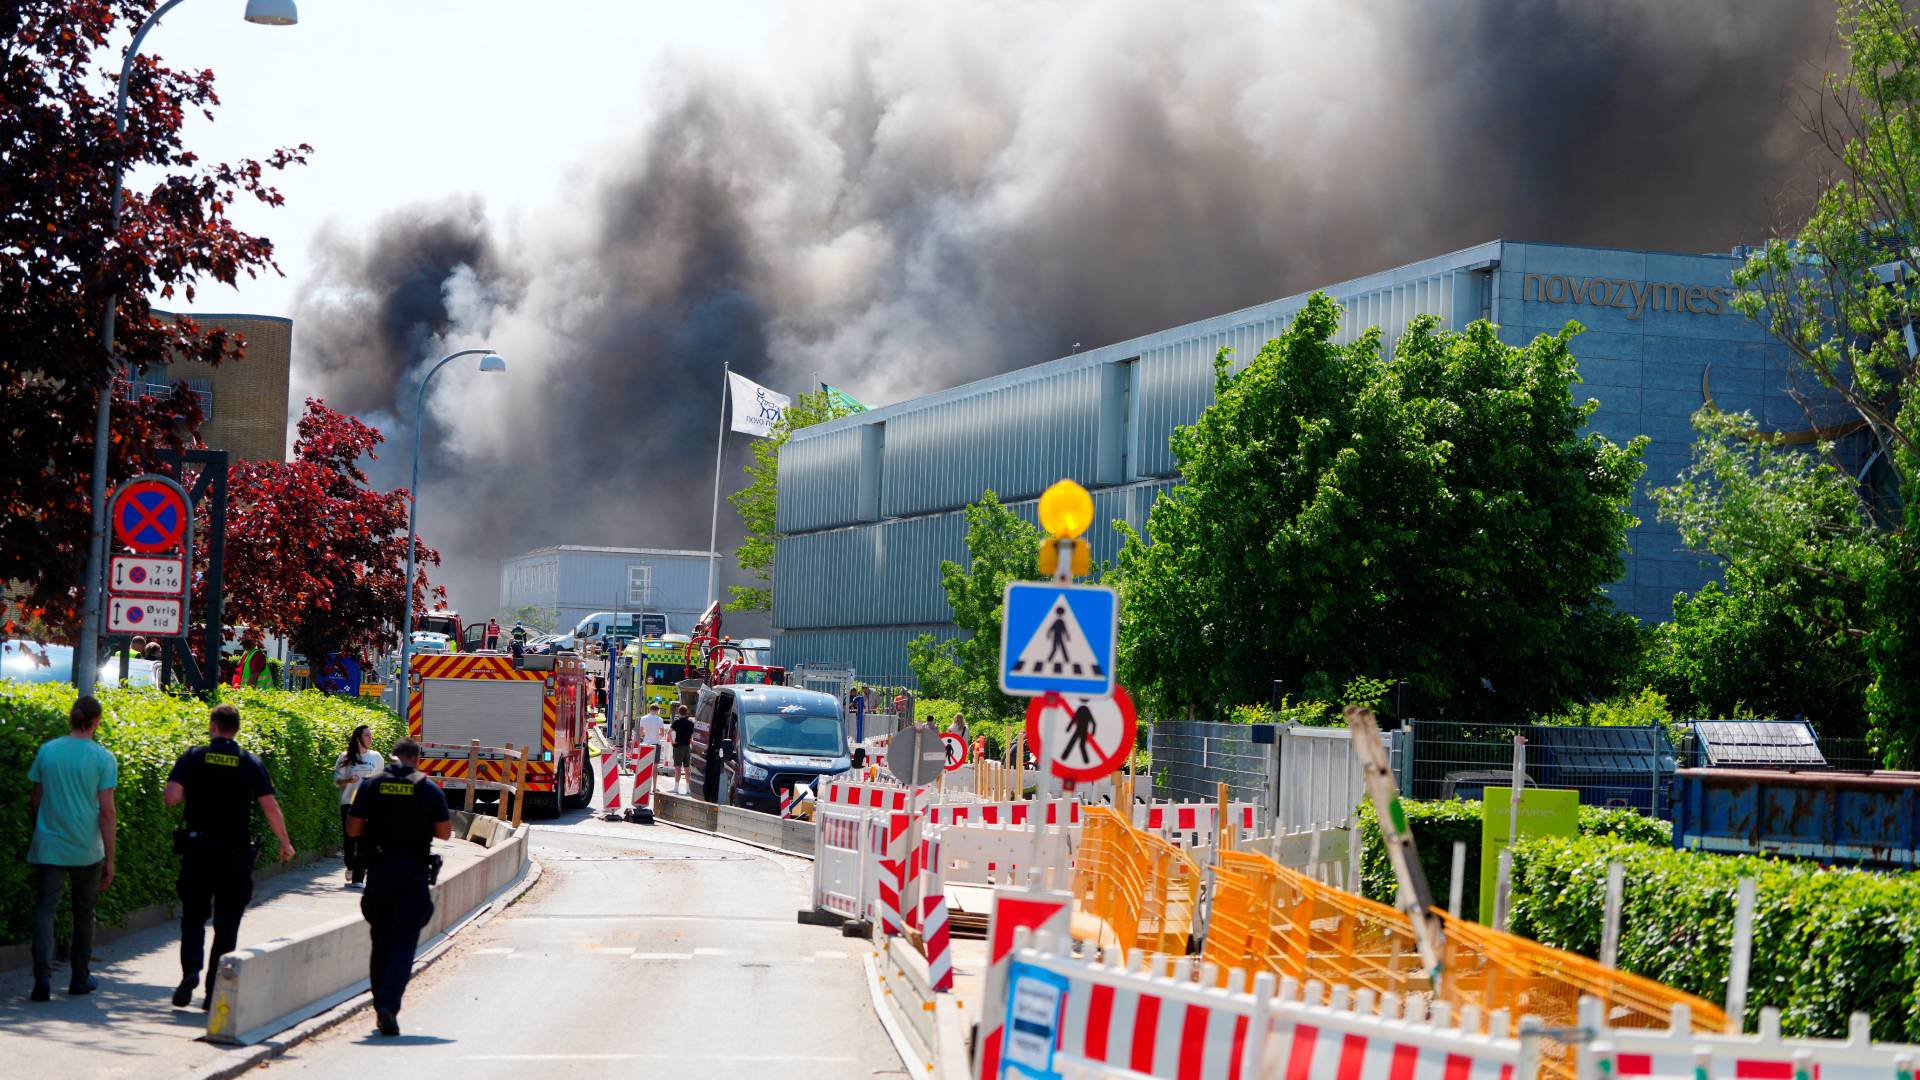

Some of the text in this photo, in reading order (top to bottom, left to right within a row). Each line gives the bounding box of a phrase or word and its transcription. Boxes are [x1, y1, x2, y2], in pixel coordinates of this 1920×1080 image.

[1523, 273, 1725, 320] novozymes
[149, 578, 178, 587] 14-16
[147, 605, 176, 617] Øvrig
[154, 619, 168, 627] tid
[655, 669, 664, 679] H
[207, 754, 239, 766] POLITI
[380, 784, 414, 794] POLITI
